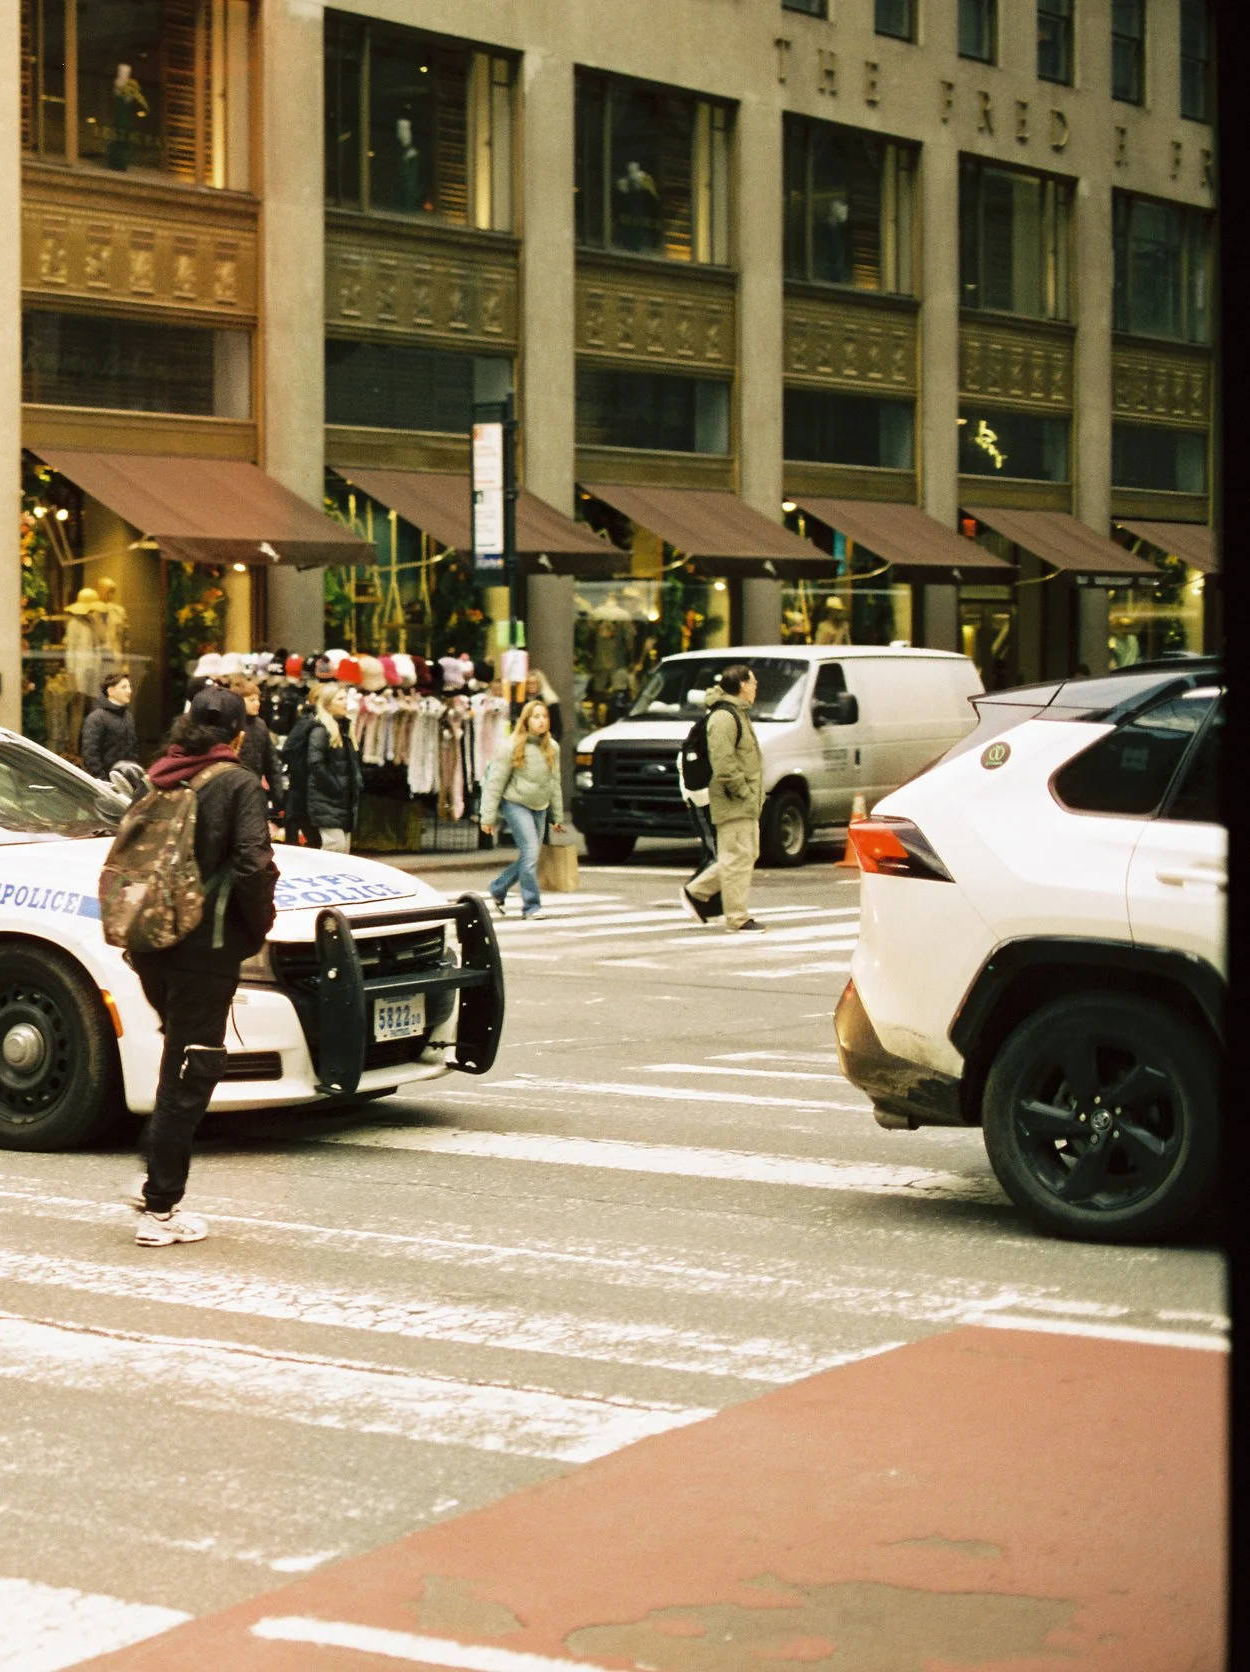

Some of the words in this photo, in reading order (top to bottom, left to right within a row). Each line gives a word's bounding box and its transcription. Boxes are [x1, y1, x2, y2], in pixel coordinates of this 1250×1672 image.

[773, 37, 879, 108] THE
[940, 80, 1069, 153] FRED
[0, 883, 81, 915] POLICE
[274, 883, 403, 908] POLICE
[378, 1004, 410, 1030] 5822
